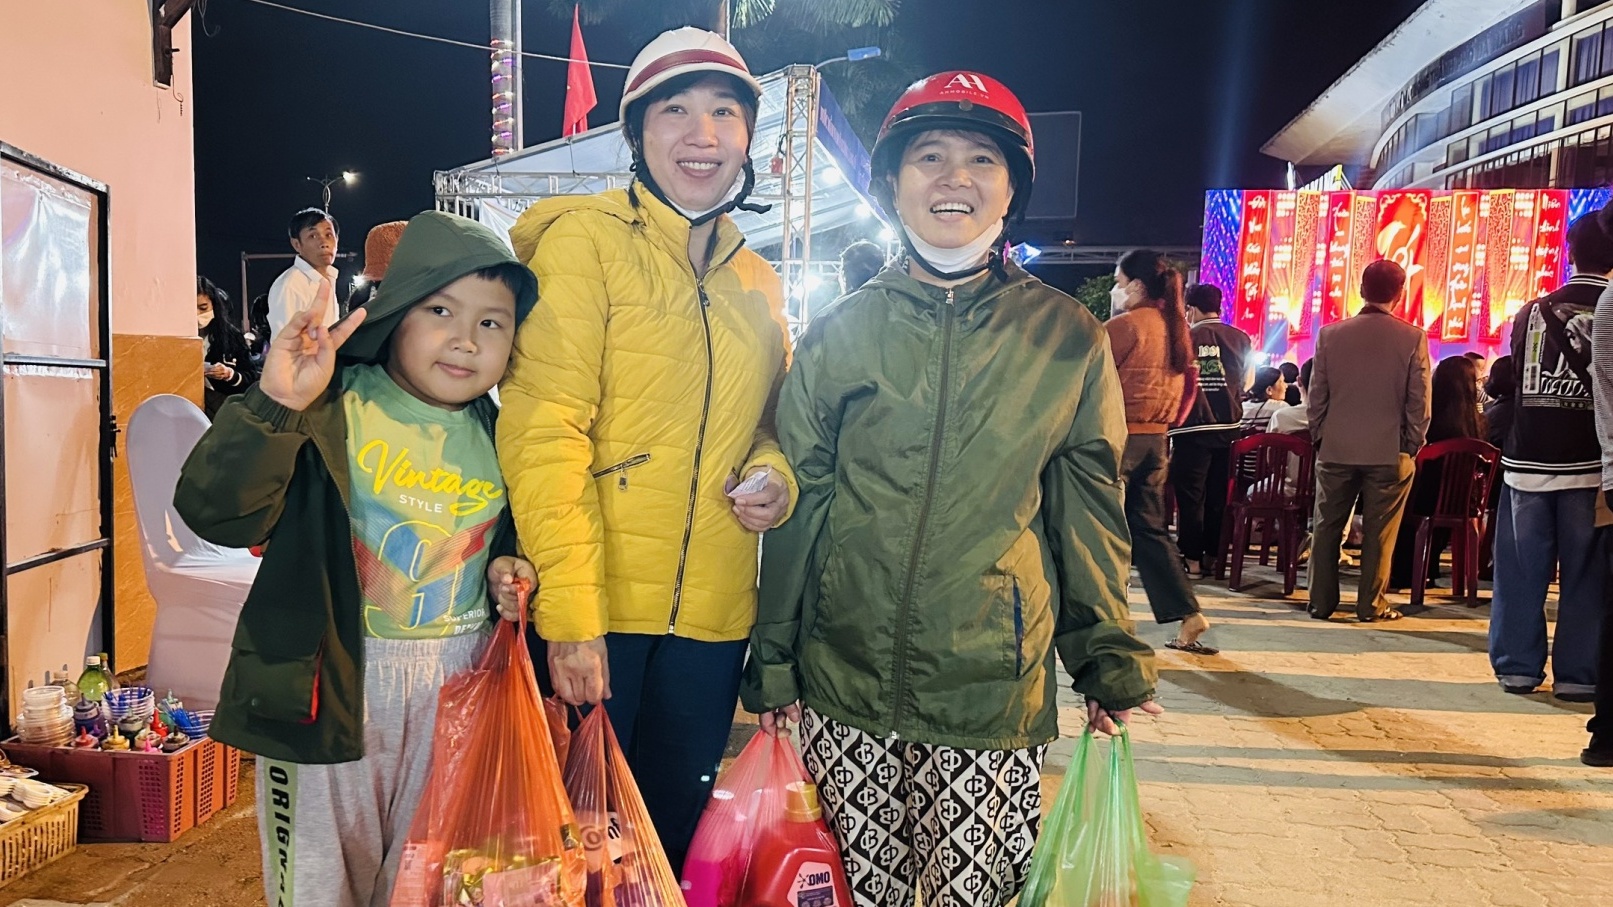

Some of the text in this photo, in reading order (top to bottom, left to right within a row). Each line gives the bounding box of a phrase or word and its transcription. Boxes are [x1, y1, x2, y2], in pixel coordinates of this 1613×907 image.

[357, 439, 503, 516] Vintage
[399, 494, 443, 513] STYLE
[808, 871, 831, 886] OMO
